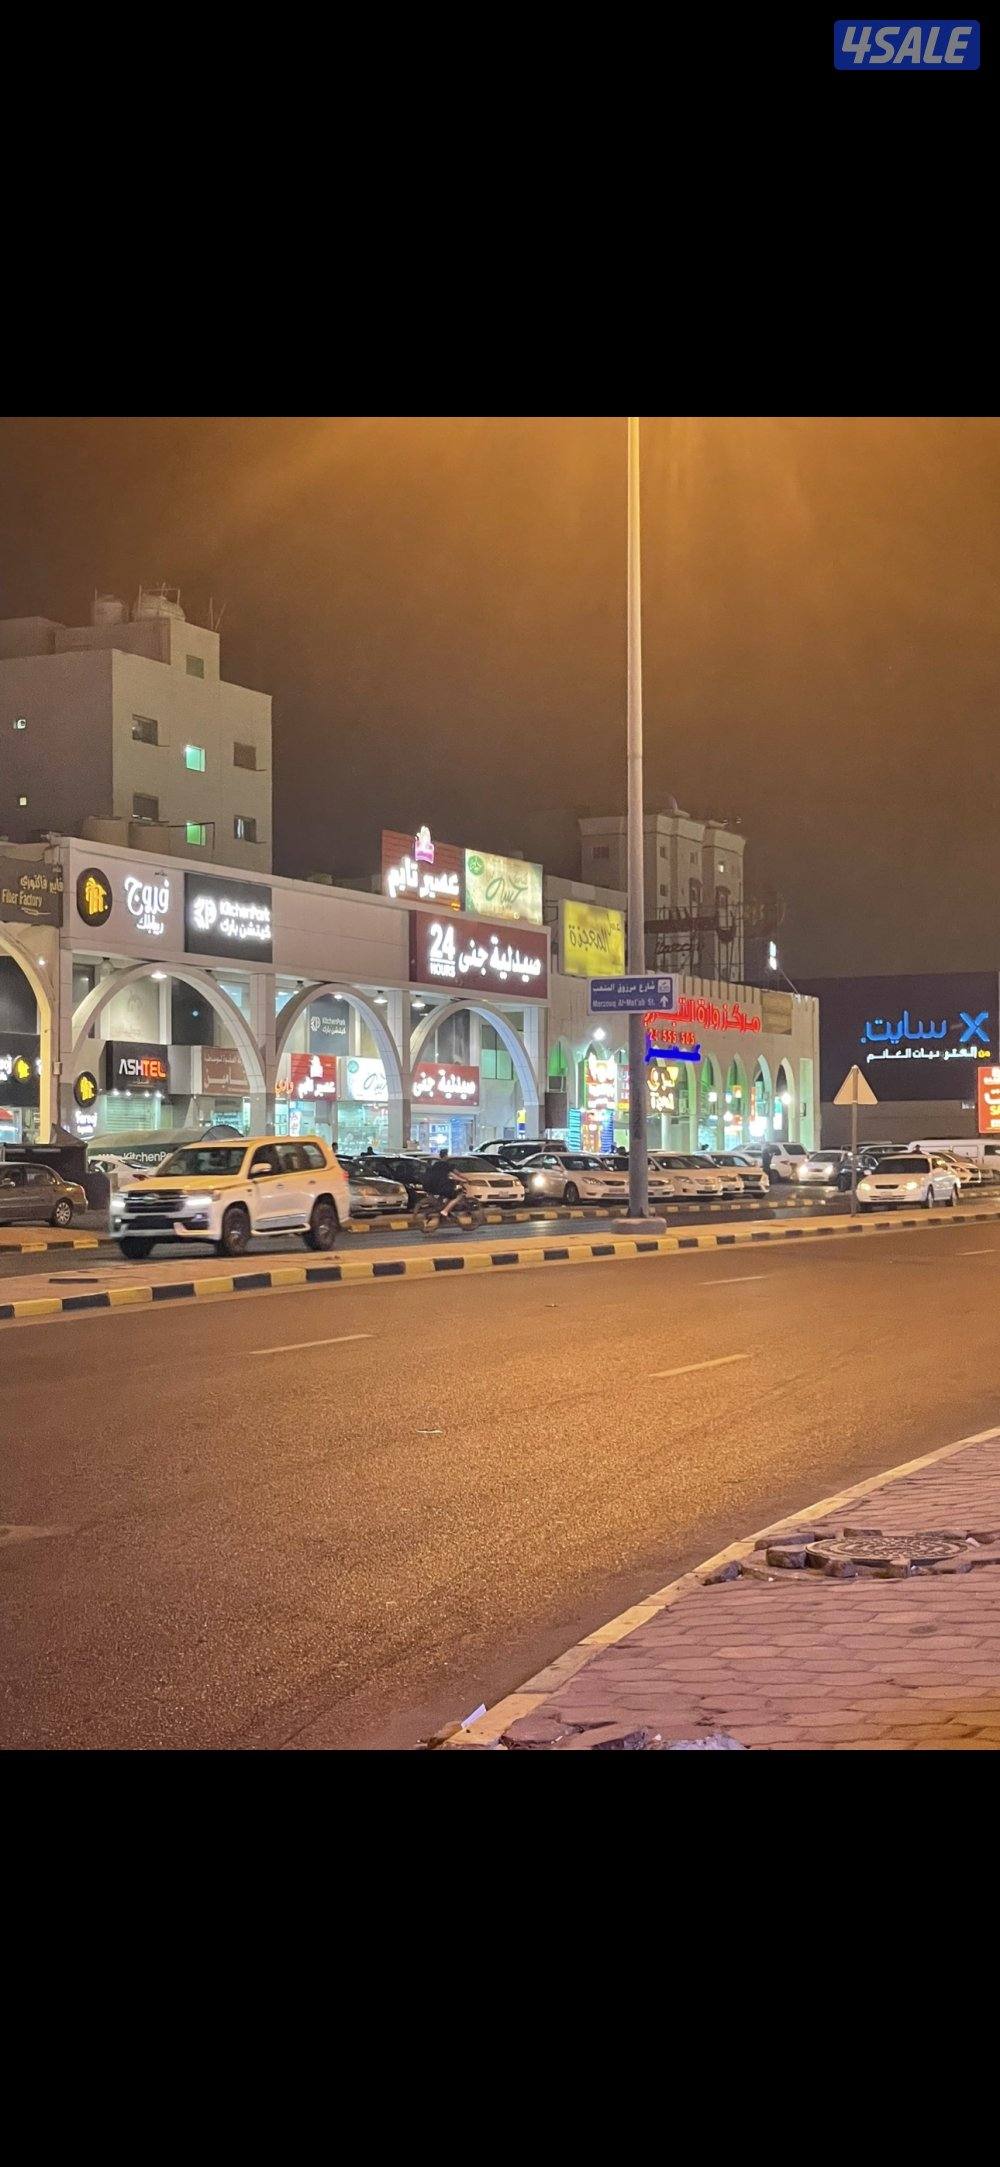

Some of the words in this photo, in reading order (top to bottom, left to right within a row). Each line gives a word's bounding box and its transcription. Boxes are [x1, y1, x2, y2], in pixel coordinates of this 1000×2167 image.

[388, 857, 419, 898] تايم
[419, 873, 460, 898] عصير
[124, 877, 169, 915] فروج
[430, 924, 455, 960] 24
[429, 961, 456, 977] HOURS
[490, 935, 541, 982] صيدلية
[639, 981, 655, 993] شارع
[119, 1058, 166, 1078] ASHTEL
[437, 1069, 476, 1100] صيدلية
